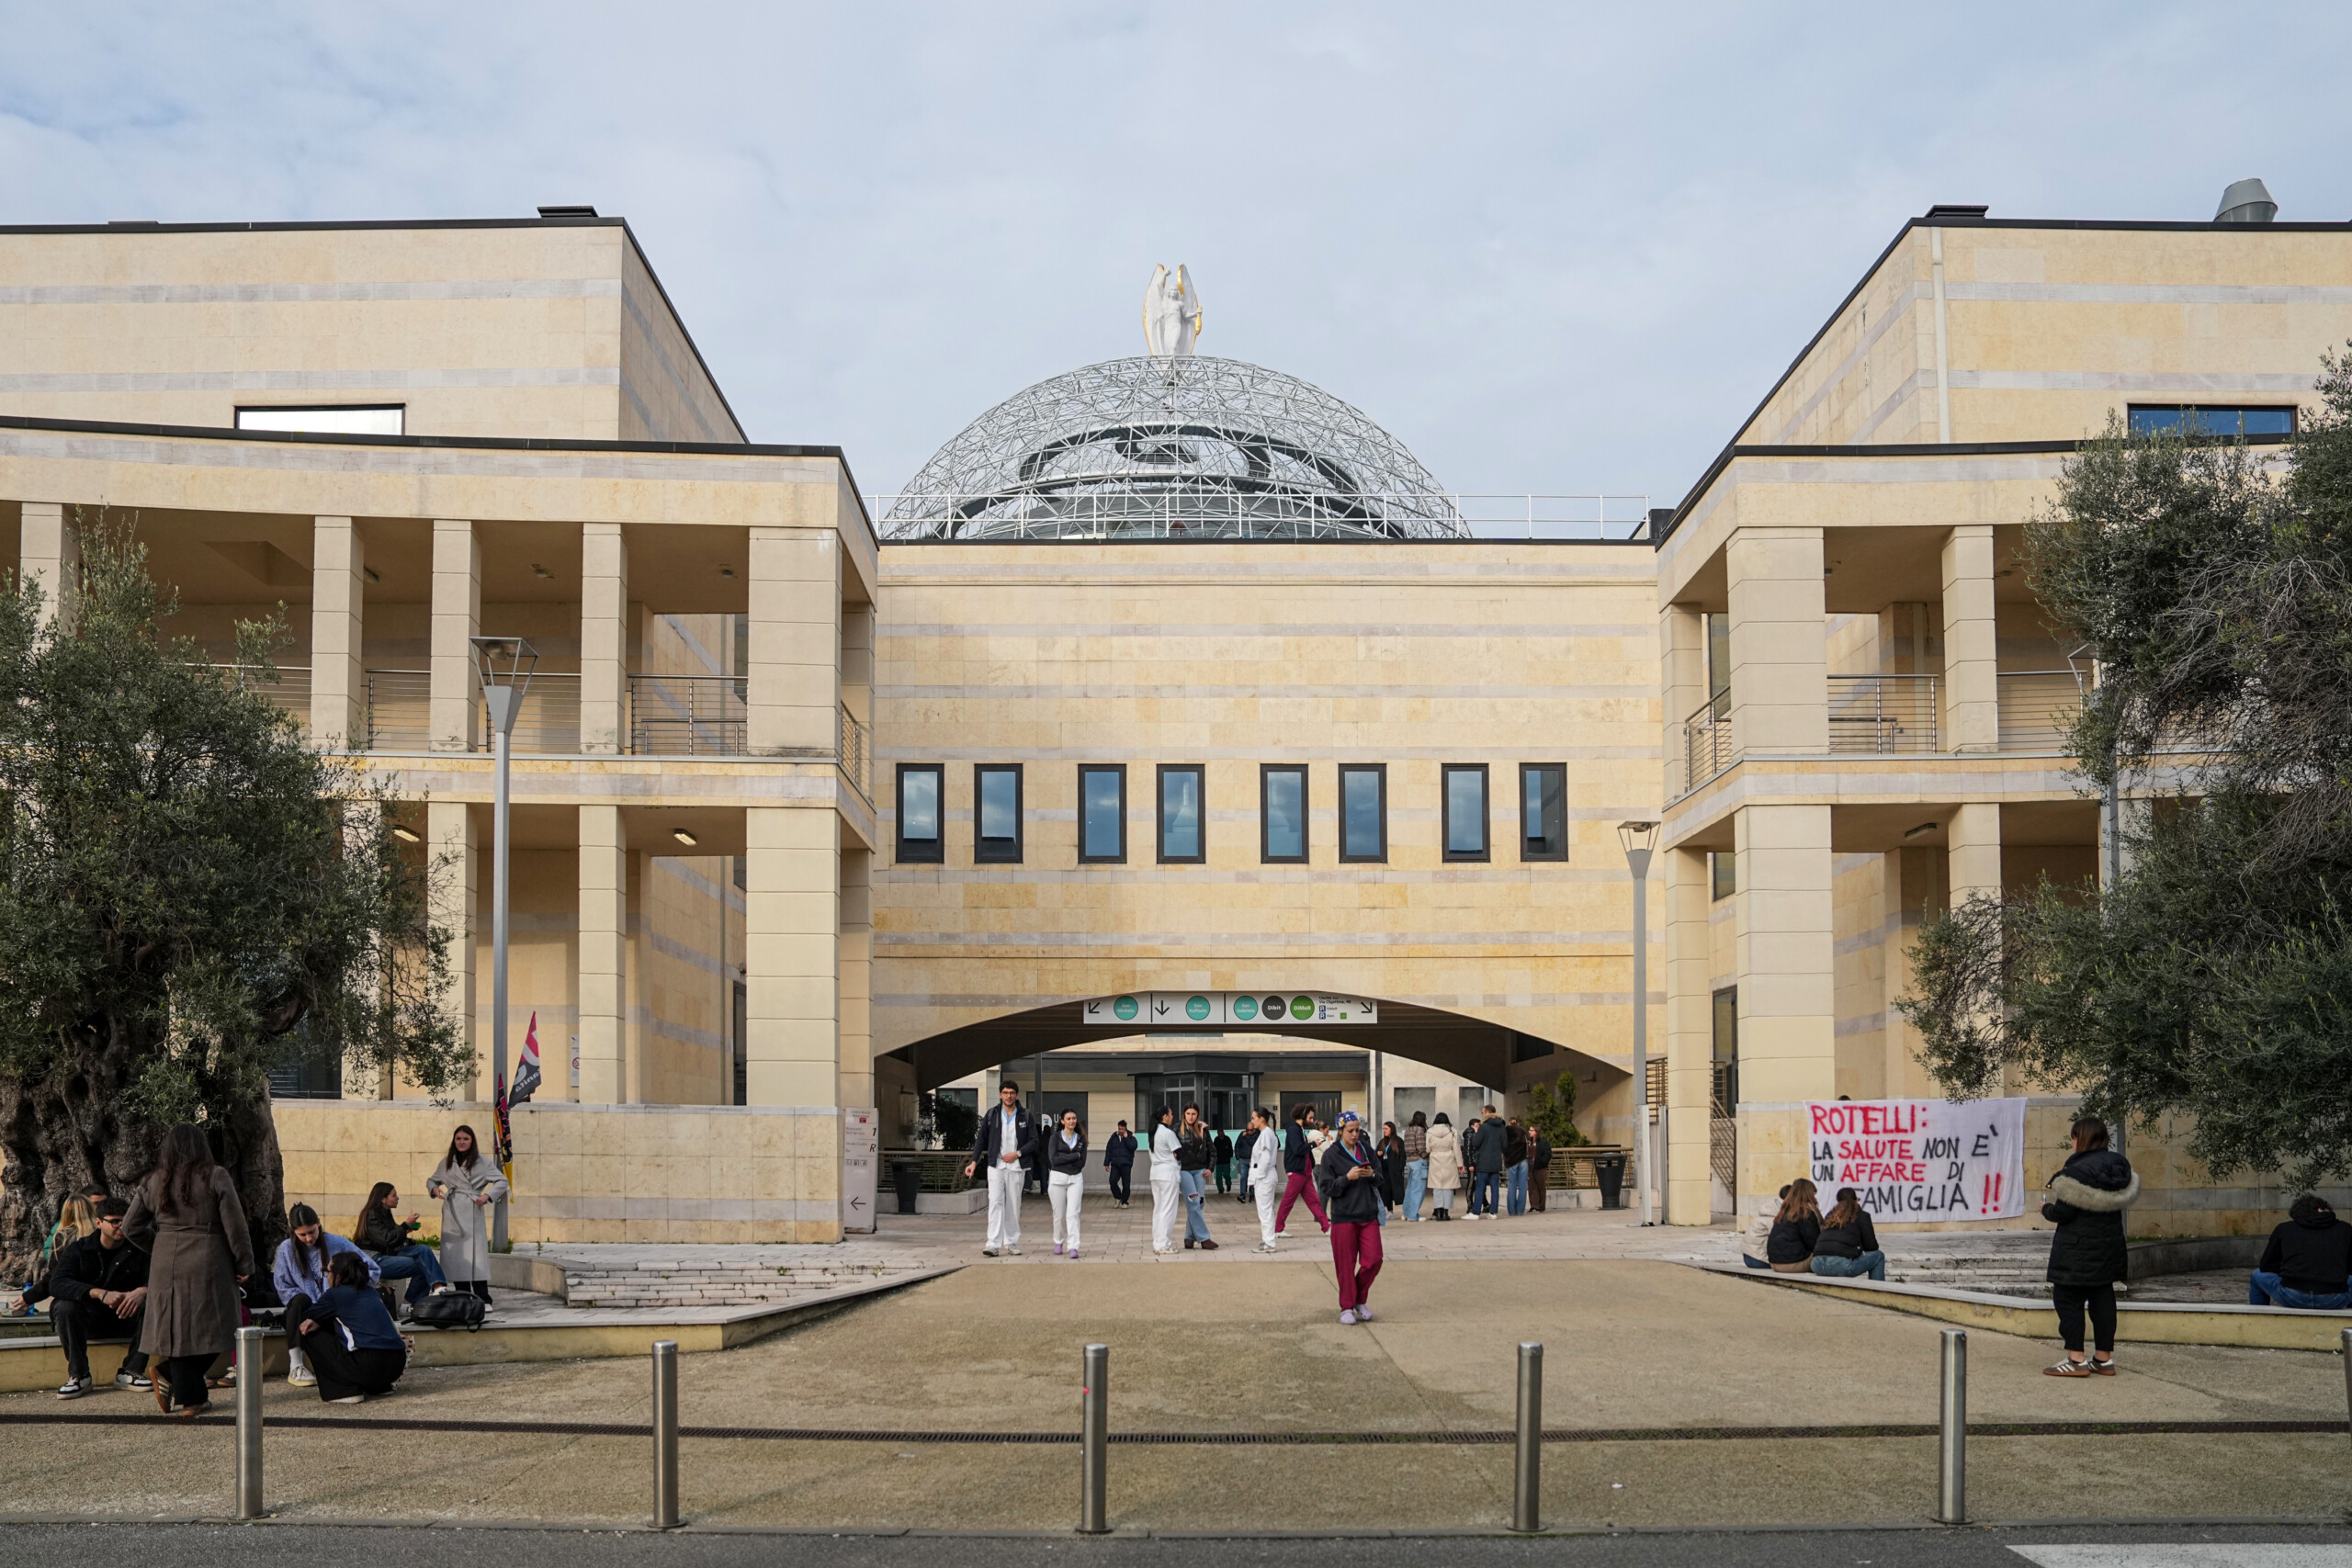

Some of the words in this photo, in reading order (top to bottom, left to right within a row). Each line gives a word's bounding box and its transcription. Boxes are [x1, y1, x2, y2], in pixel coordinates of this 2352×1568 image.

[1810, 1104, 1928, 1135] ROTELLI:
[869, 1144, 876, 1153] R
[1813, 1141, 1834, 1160] LA
[1838, 1140, 1914, 1160] SALUTE
[1922, 1136, 1960, 1159] NON
[1812, 1164, 1835, 1182] UN
[1840, 1162, 1927, 1182] AFFARE
[1947, 1161, 1964, 1181] DI
